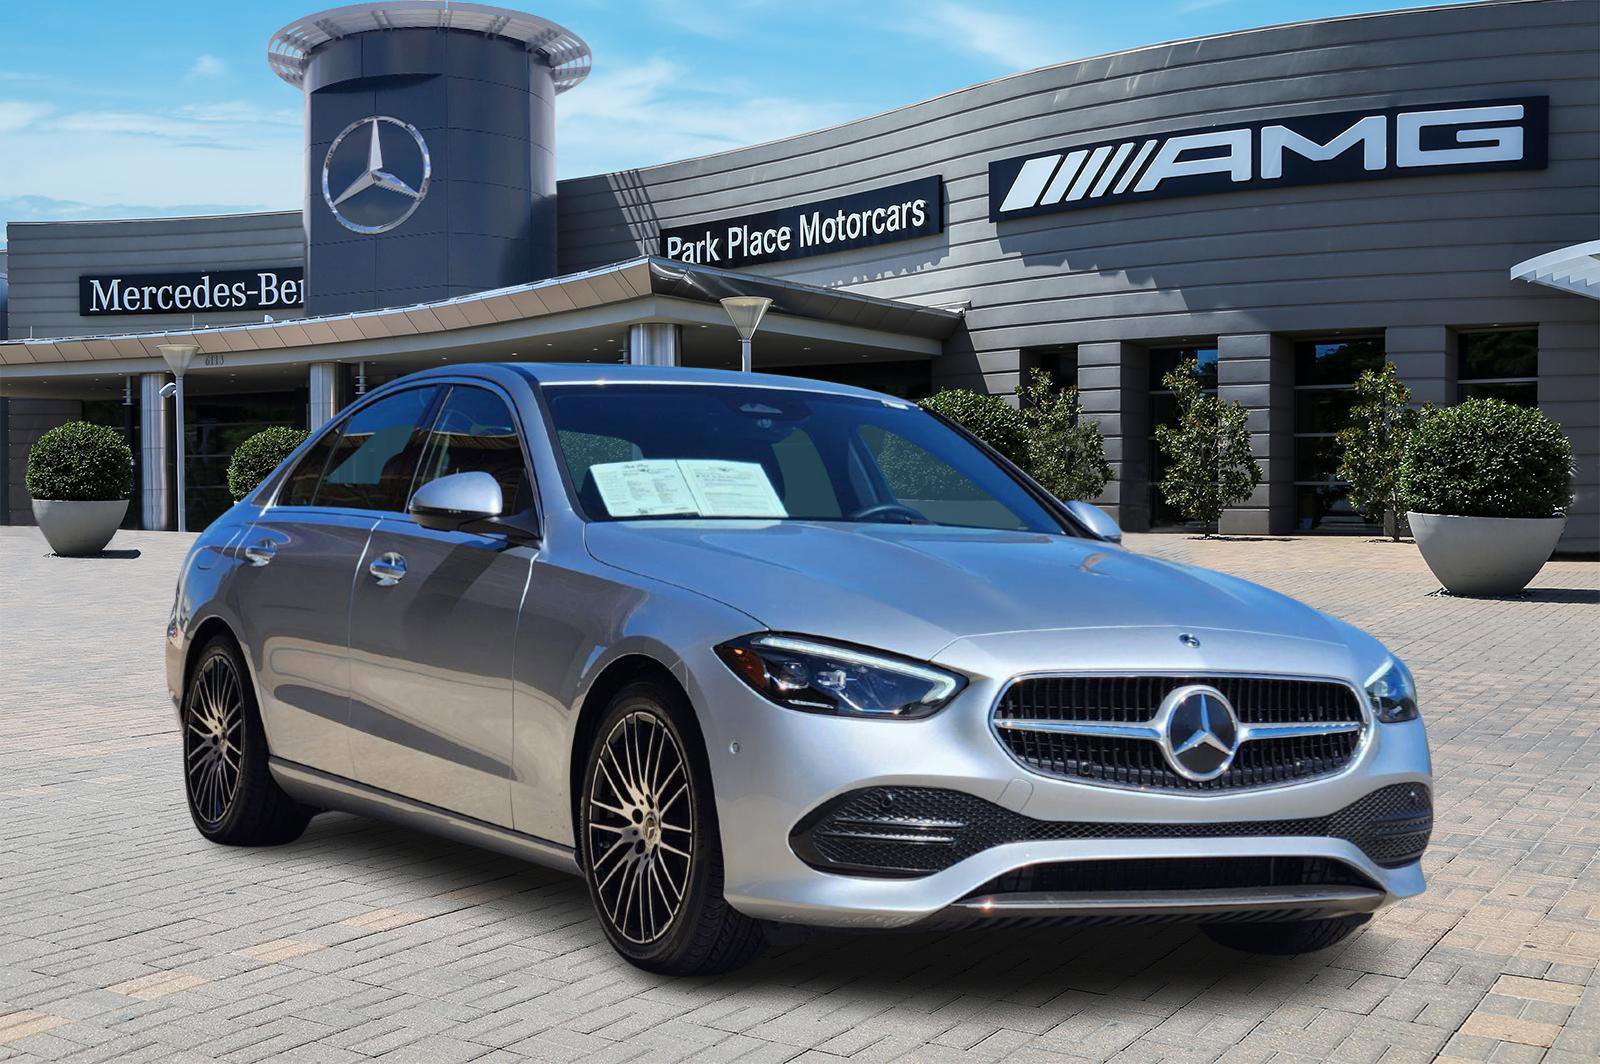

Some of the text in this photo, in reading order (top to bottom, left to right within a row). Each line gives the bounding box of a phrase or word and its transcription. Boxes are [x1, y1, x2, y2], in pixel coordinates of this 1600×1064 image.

[667, 199, 927, 264] Park Place Motorcars
